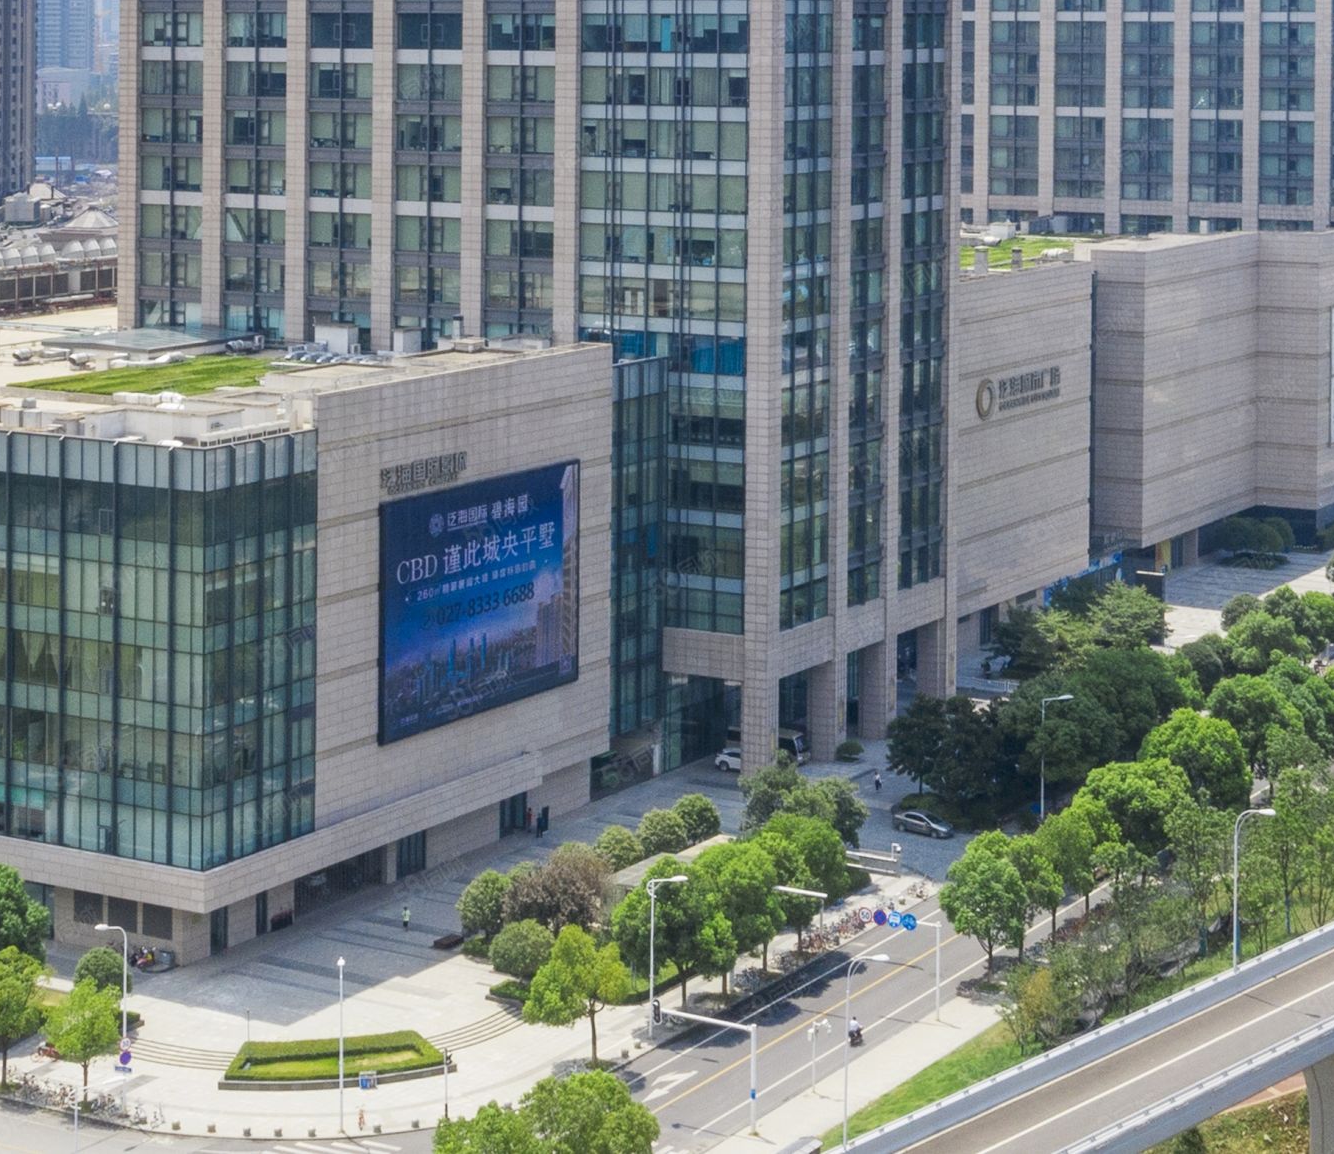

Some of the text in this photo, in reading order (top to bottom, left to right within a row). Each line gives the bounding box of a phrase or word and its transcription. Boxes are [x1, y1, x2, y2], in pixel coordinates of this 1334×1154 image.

[447, 494, 529, 527] 泛海国际 碧海园
[396, 554, 438, 585] CBD
[442, 521, 556, 575] 谨此城央平墅
[503, 582, 535, 607] 6688
